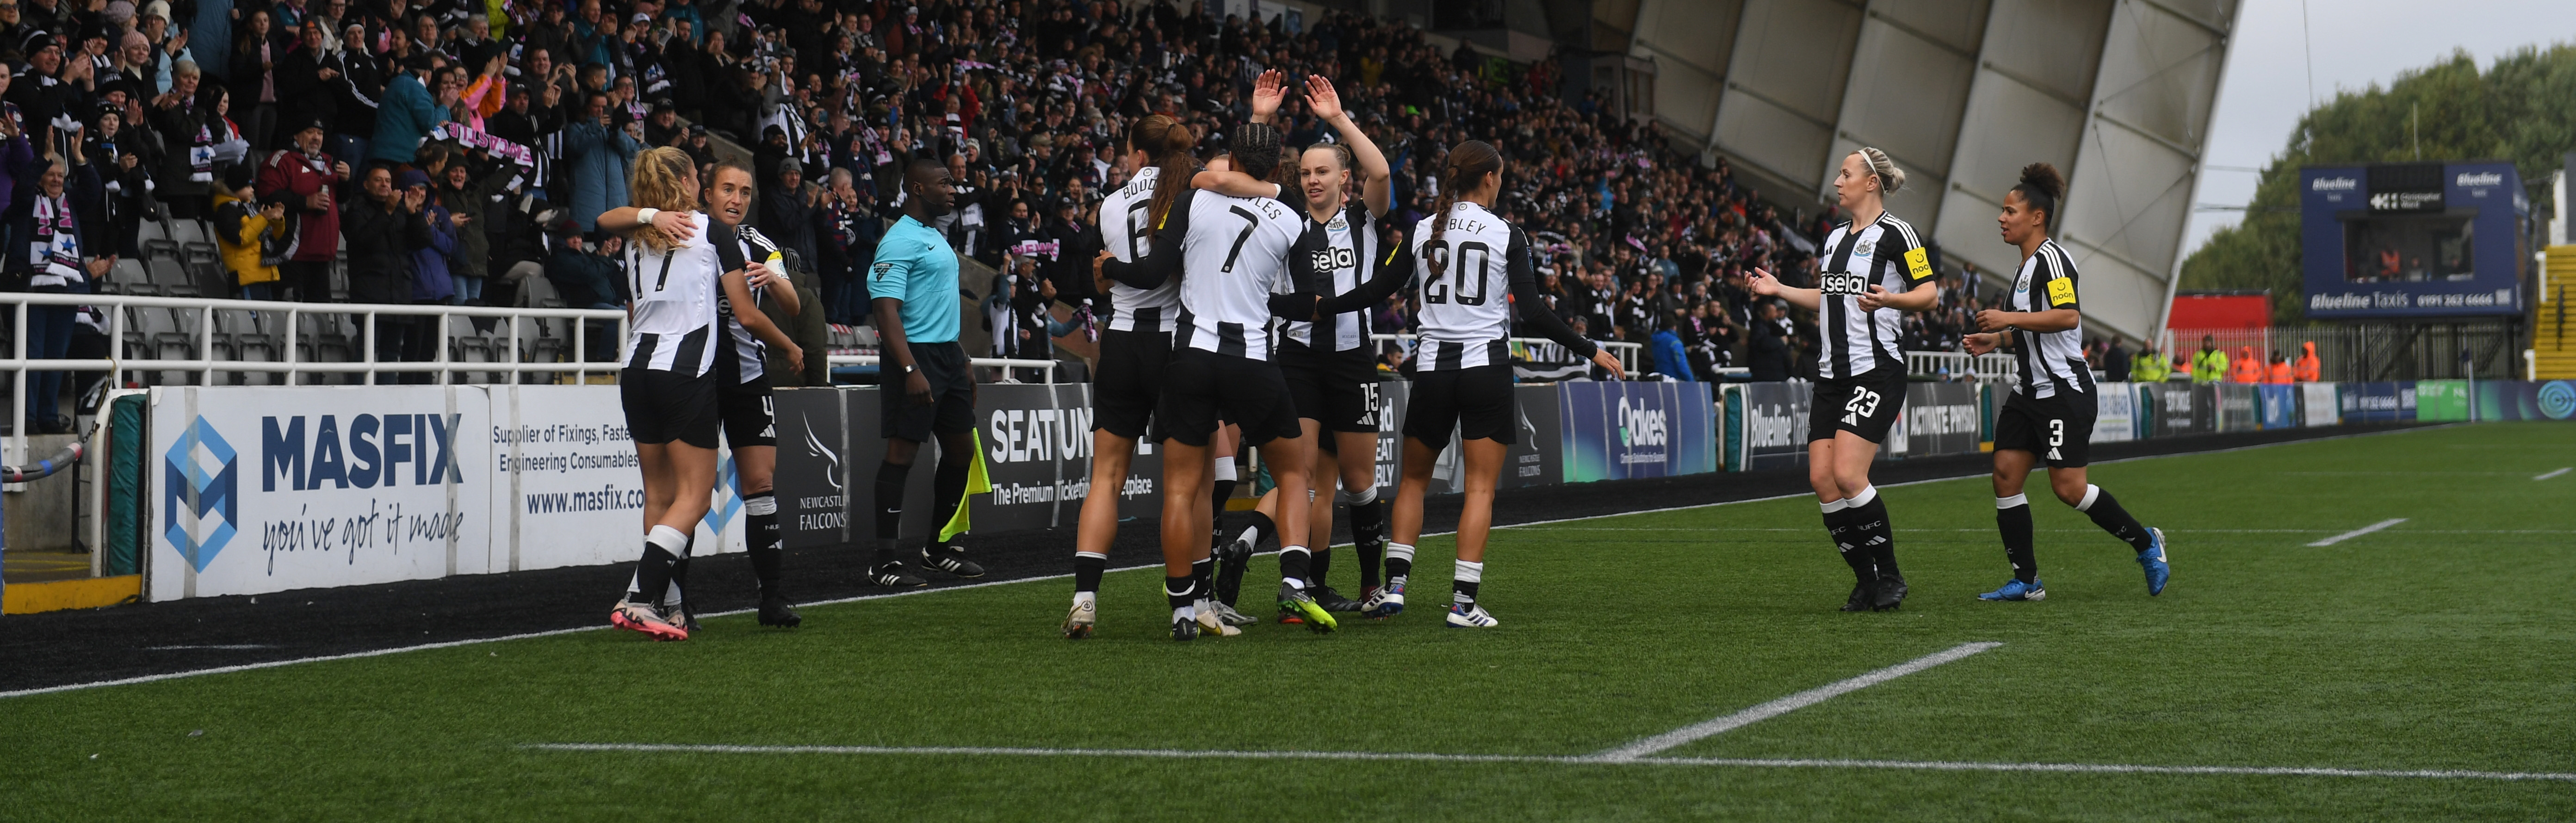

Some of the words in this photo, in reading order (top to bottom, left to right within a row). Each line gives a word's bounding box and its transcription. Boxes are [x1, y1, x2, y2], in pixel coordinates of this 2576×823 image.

[2312, 177, 2357, 191] Blueline
[2457, 171, 2502, 186] Blueline
[1220, 204, 1259, 273] 7
[1443, 218, 1486, 235] BLEY
[632, 243, 675, 299] 17
[1312, 248, 1353, 270] sela
[1422, 240, 1489, 306] 20
[2053, 292, 2074, 302] noon
[2310, 292, 2371, 309] Blueline
[2372, 290, 2409, 309] Taxis
[2417, 294, 2443, 307] 0191
[2443, 293, 2465, 307] 262
[2465, 293, 2494, 306] 6666
[762, 396, 775, 424] 4
[1360, 383, 1379, 411] 15
[1845, 386, 1881, 418] 23
[1618, 396, 1667, 447] Oakes
[1750, 403, 1792, 448] Blueline
[1910, 406, 1949, 436] ACTIVATE
[1950, 404, 1976, 433] PHYSIO
[2049, 419, 2063, 447] 3
[493, 425, 540, 444] Supplier
[544, 424, 556, 442] of
[558, 424, 600, 445] Fixings,
[603, 424, 634, 441] Faste
[262, 413, 464, 492] MASFIX
[500, 453, 567, 474] Engineering
[570, 450, 638, 469] Consumables
[1375, 438, 1394, 461] EAT
[992, 483, 1011, 505] The
[1013, 480, 1053, 504] Premium
[1055, 476, 1090, 501] Ticketin
[1121, 474, 1152, 500] etplace
[1375, 464, 1394, 487] BLY
[527, 484, 644, 514] www.masfix.co
[800, 495, 849, 509] NEWCASTL
[342, 498, 379, 565] got
[387, 503, 403, 555] it
[409, 498, 464, 543] made
[800, 512, 847, 531] FALCONS
